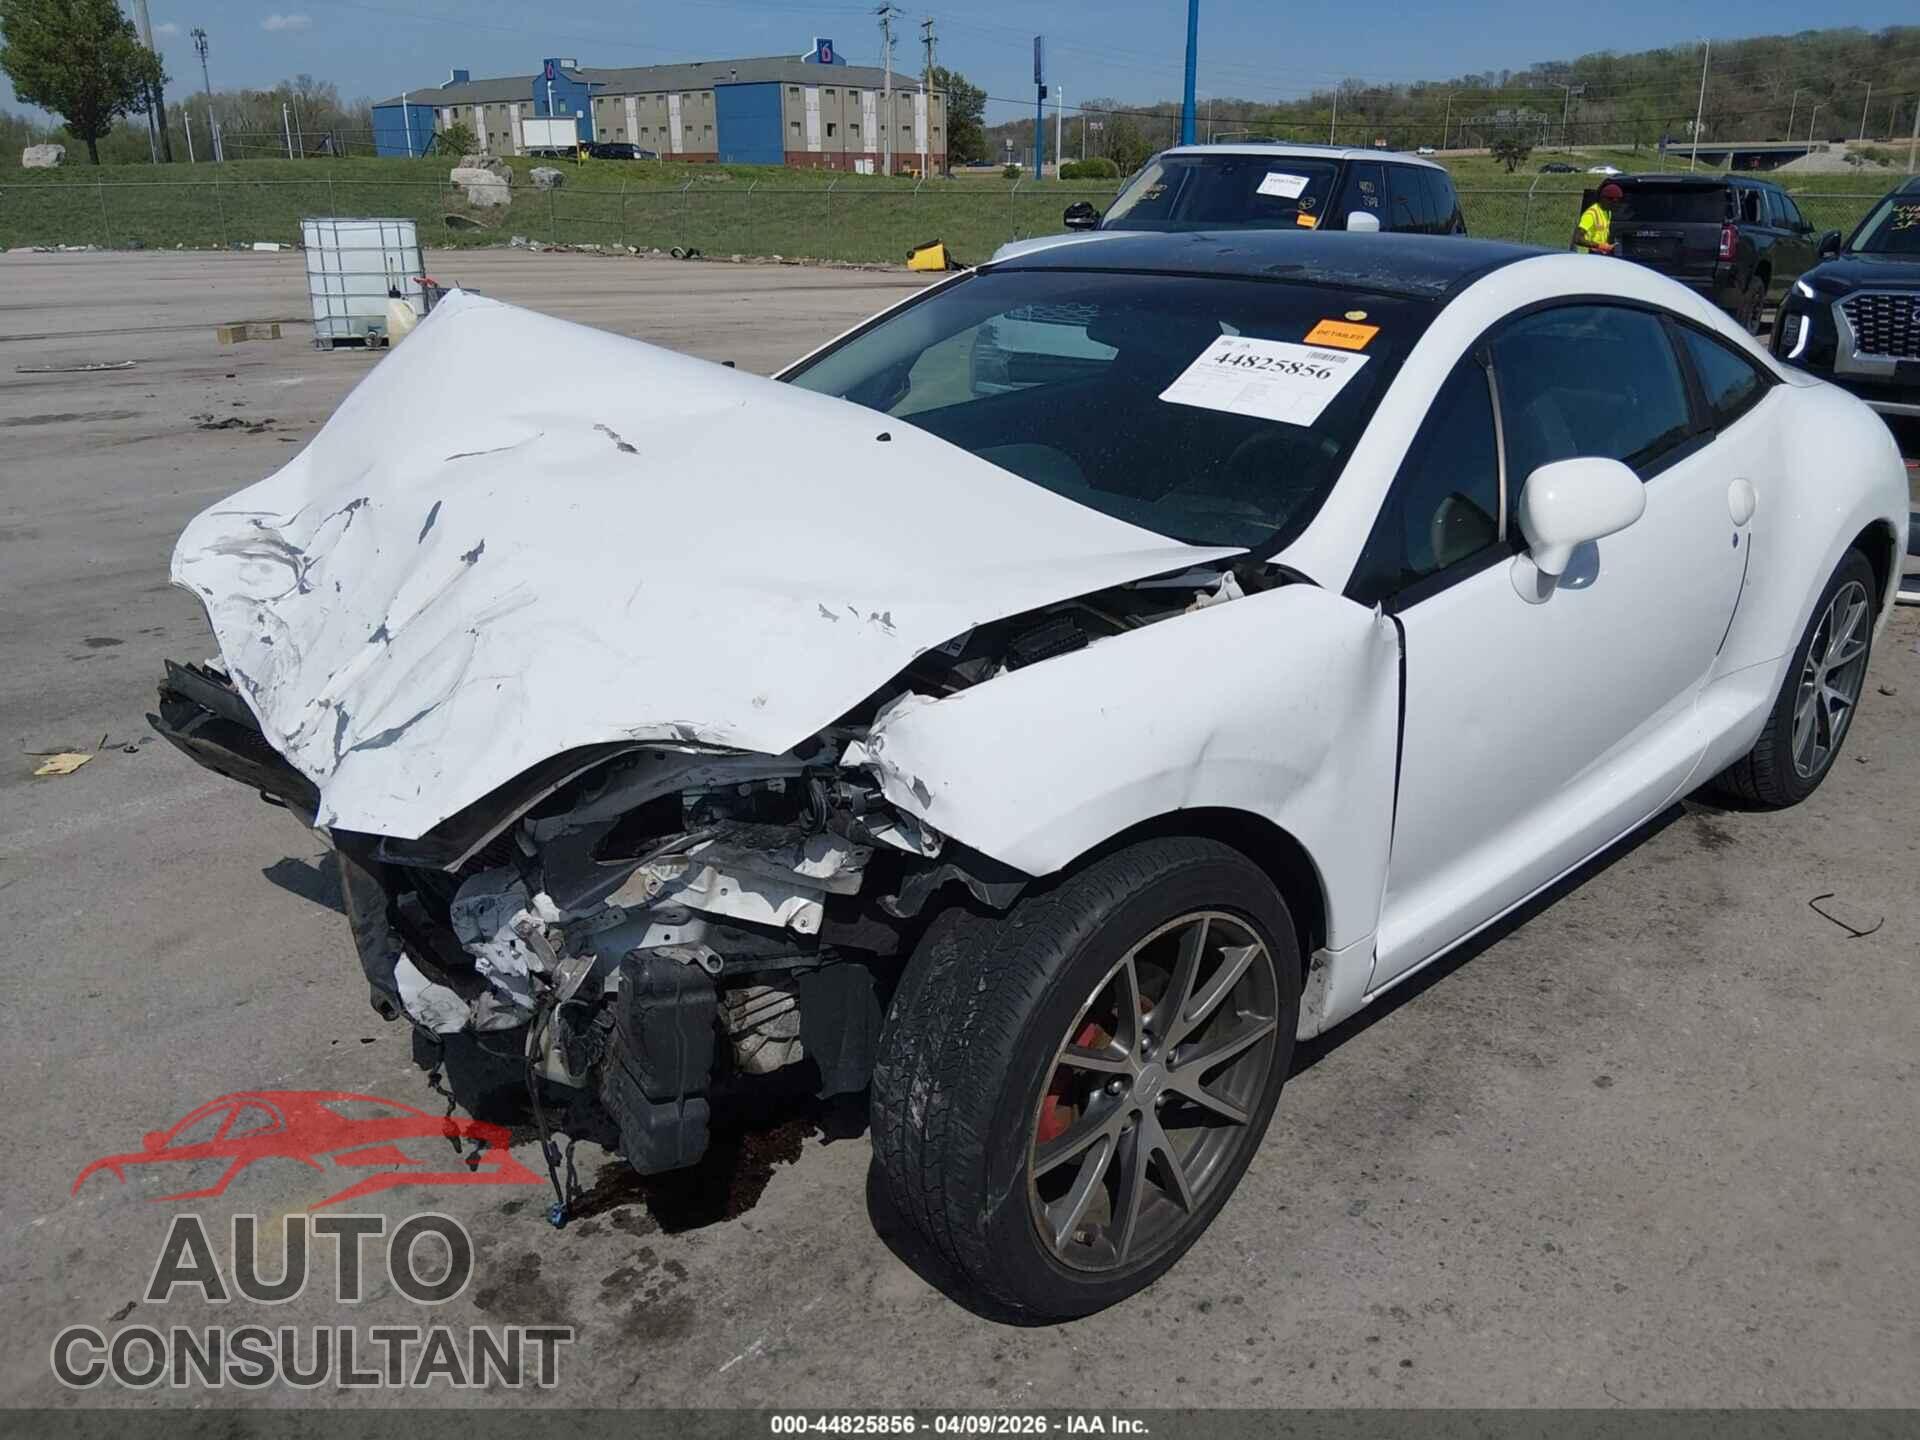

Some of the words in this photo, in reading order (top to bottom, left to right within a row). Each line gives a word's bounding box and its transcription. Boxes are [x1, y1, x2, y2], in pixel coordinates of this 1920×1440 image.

[820, 42, 832, 62] 6
[546, 61, 554, 80] 6
[1316, 329, 1364, 341] DETAILED
[1215, 352, 1332, 380] 44825856
